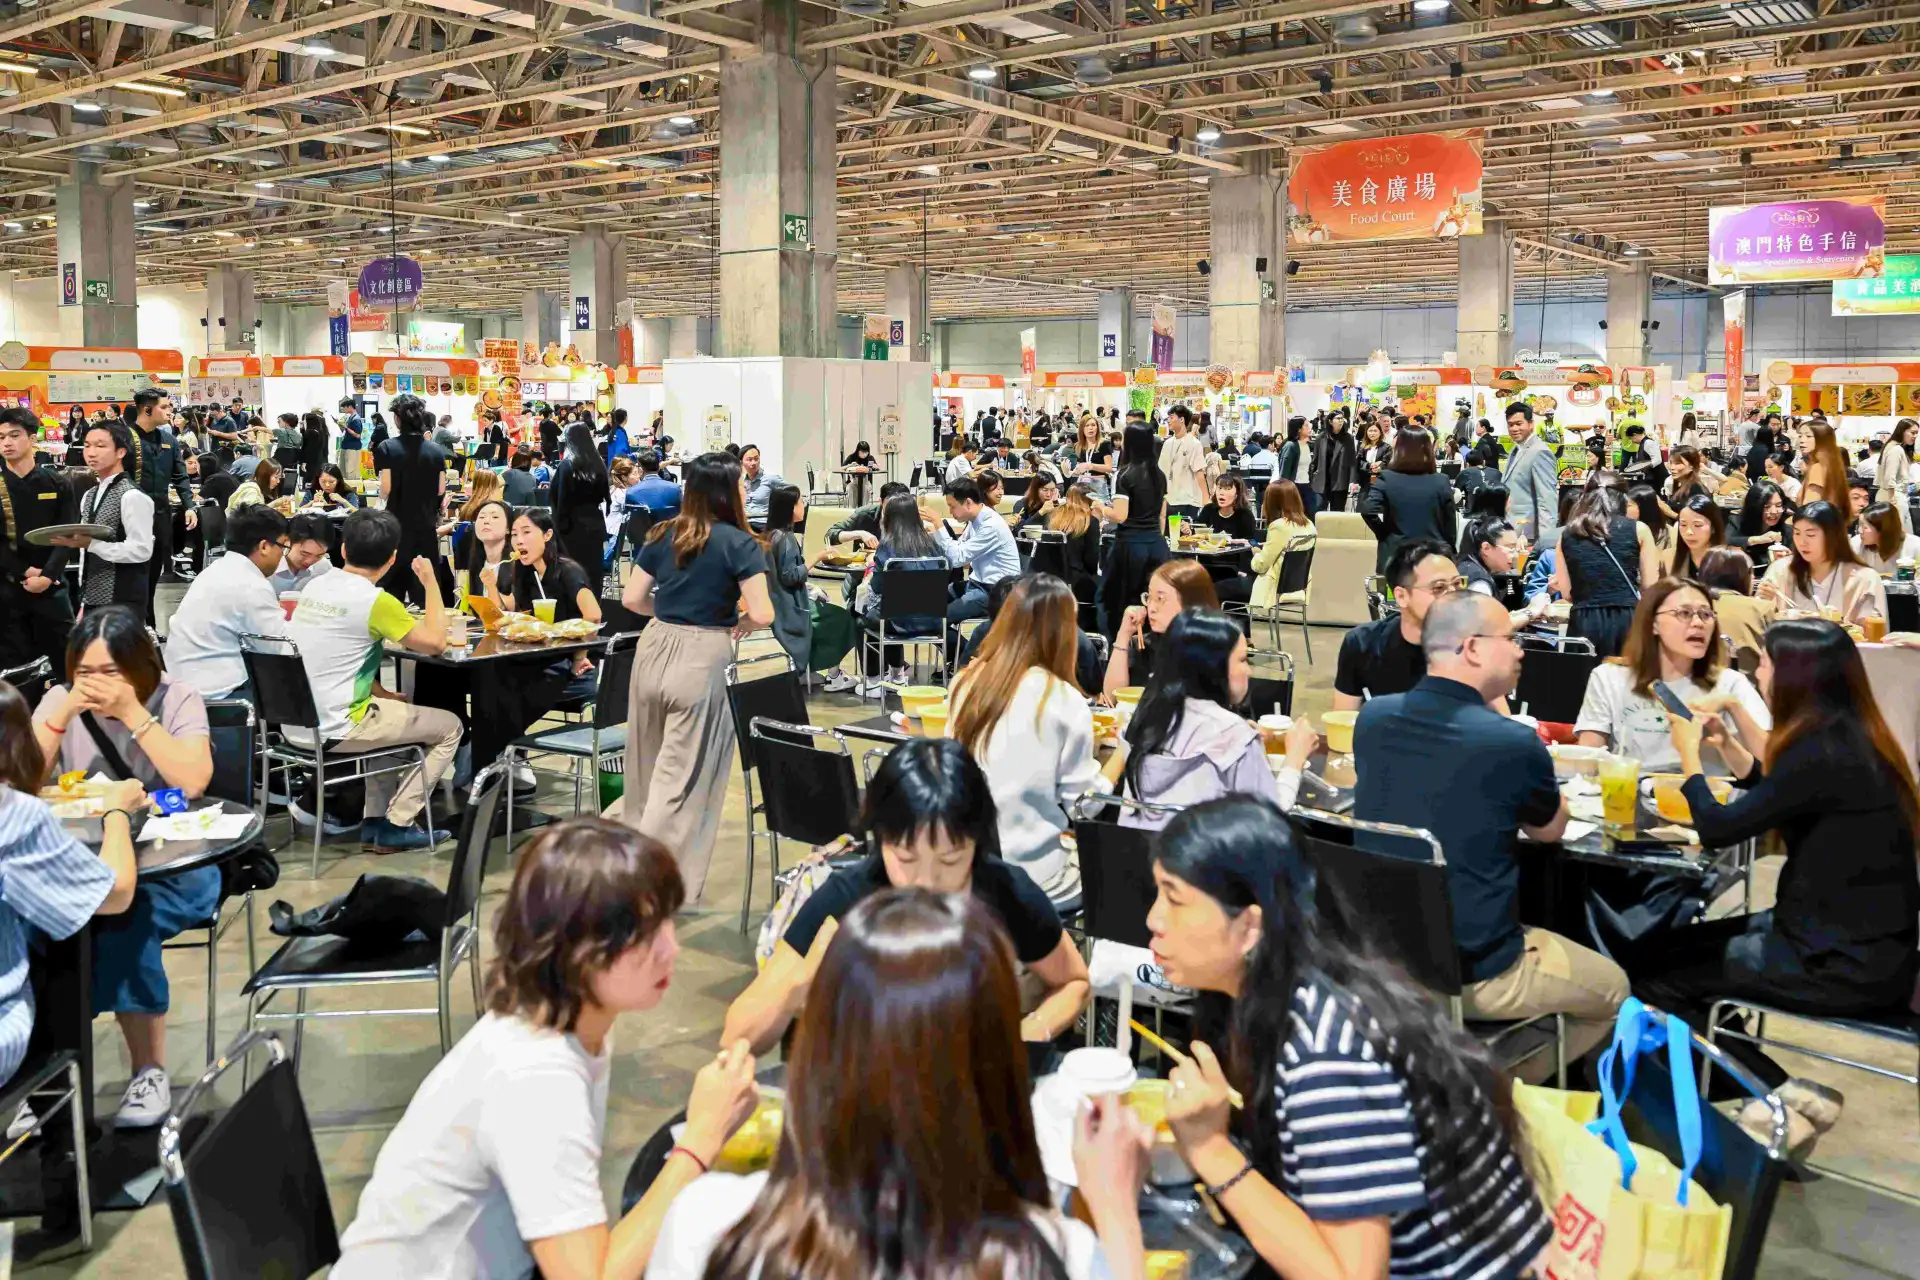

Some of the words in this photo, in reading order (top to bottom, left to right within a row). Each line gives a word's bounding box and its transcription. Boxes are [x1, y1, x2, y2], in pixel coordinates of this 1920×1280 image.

[1331, 172, 1437, 208] 美食廣場
[1349, 210, 1379, 226] Food
[1382, 208, 1417, 222] Court
[1735, 231, 1857, 255] 澳門特色手信
[1806, 256, 1814, 264] &
[1815, 254, 1856, 265] Souvenirs
[1522, 357, 1559, 365] WOODLANDS
